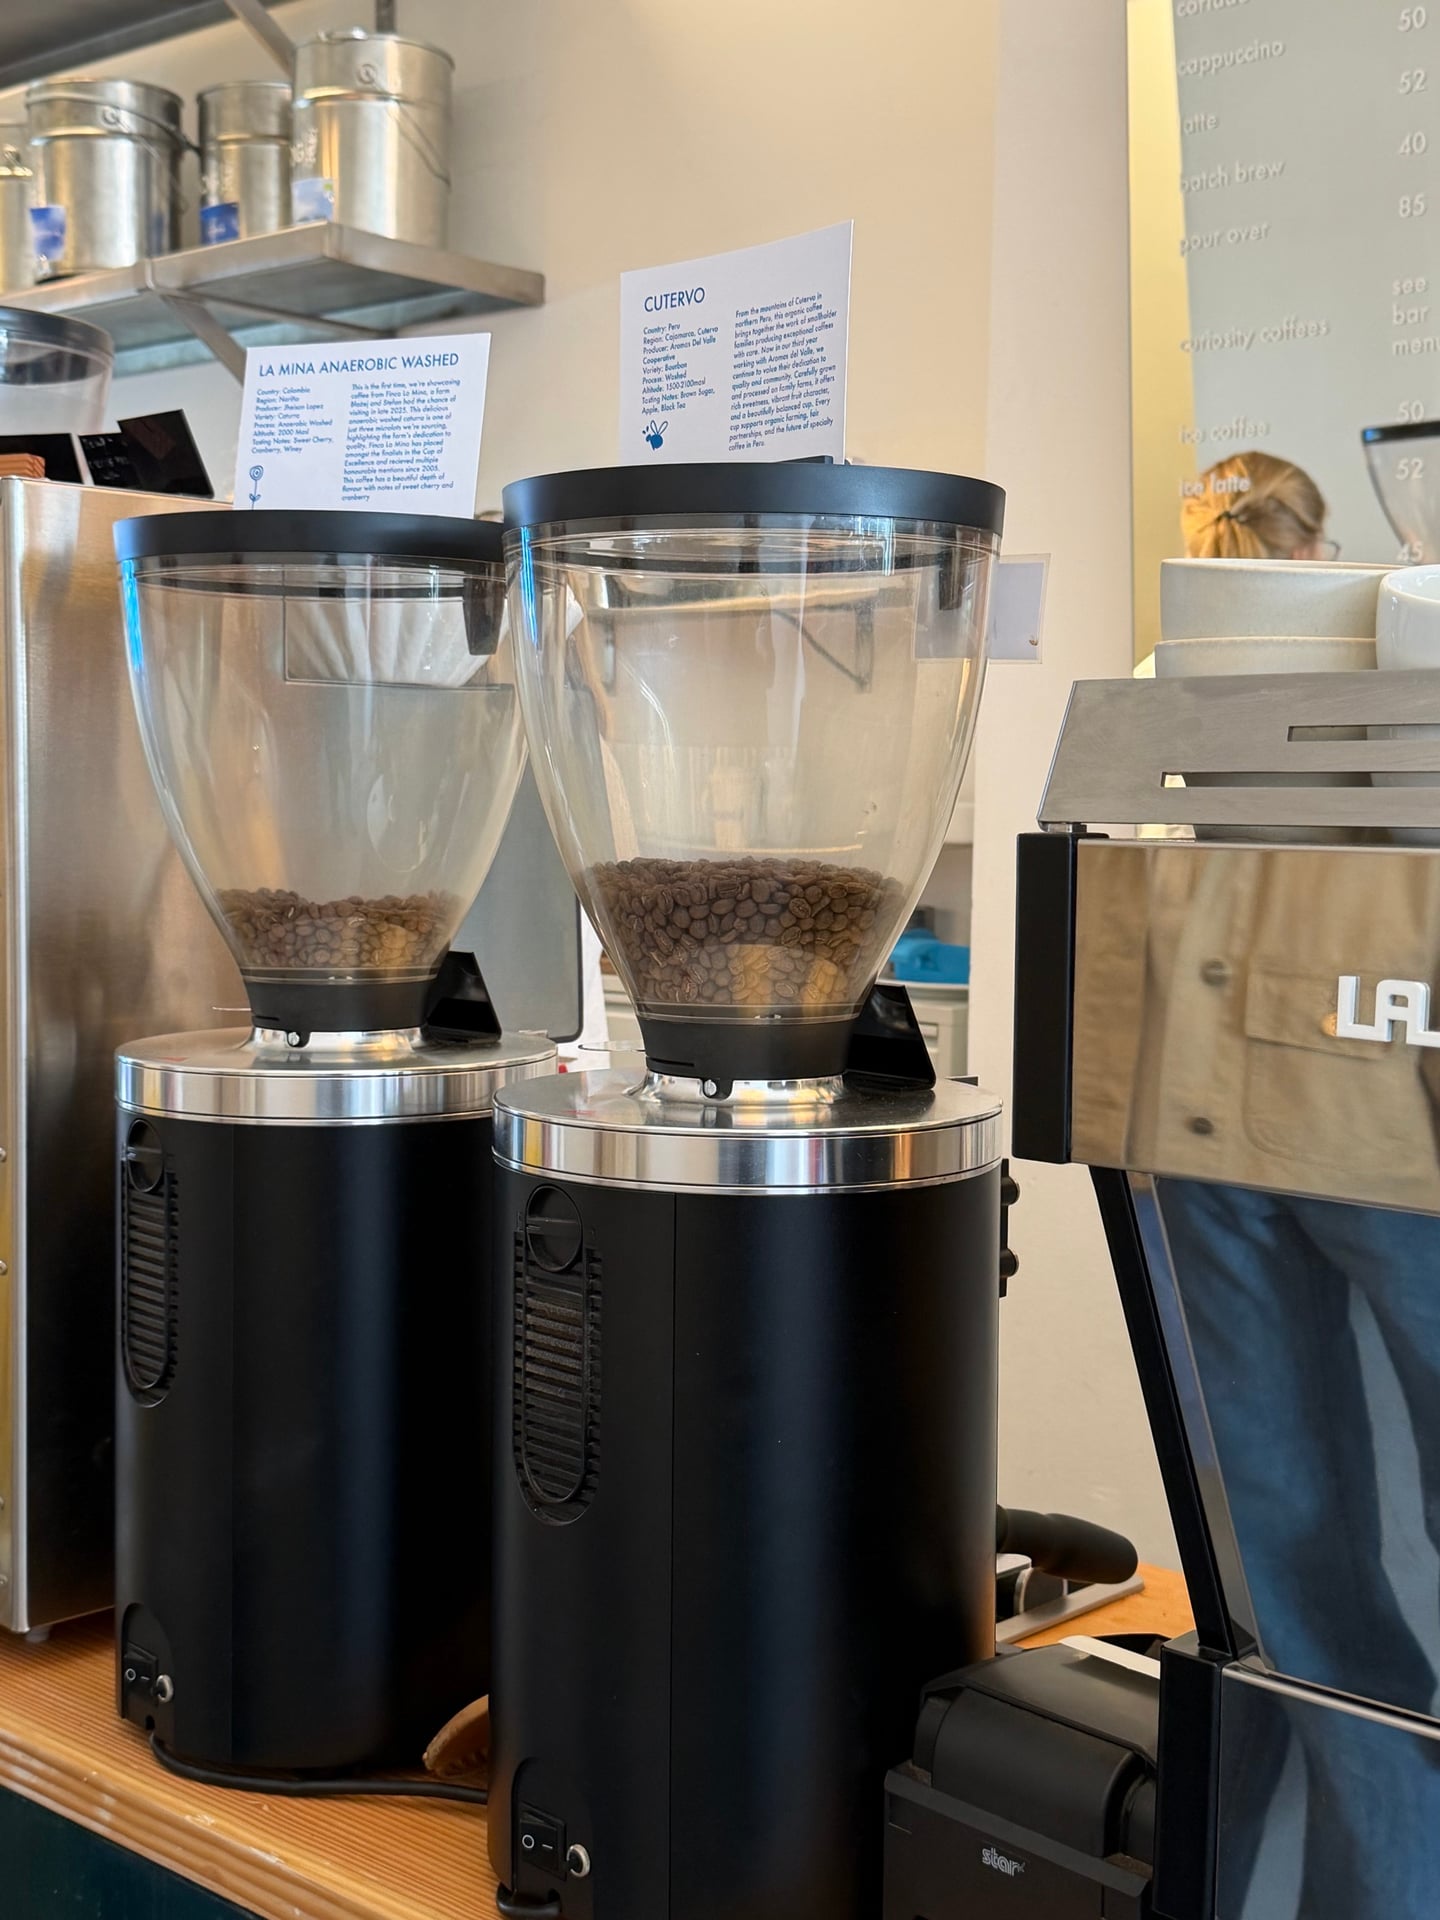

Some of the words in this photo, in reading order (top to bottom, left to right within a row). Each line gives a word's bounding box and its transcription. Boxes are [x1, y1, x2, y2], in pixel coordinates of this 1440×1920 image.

[1399, 6, 1427, 31] 50
[1178, 40, 1285, 77] cappuccino
[1400, 69, 1427, 94] 52
[1181, 112, 1217, 136] atte
[1400, 131, 1427, 155] 40
[1235, 160, 1285, 184] brew
[1399, 194, 1426, 218] 85
[1180, 230, 1221, 257] pour
[1227, 222, 1269, 244] over
[1392, 276, 1427, 297] see
[644, 287, 705, 312] CUTERVO
[1392, 303, 1429, 326] bar
[1180, 327, 1255, 352] curiosity
[1260, 314, 1330, 343] coffees
[259, 364, 275, 377] LA
[278, 361, 315, 375] MINA
[319, 357, 398, 373] ANAEROBIC
[402, 353, 459, 369] WASHED
[1397, 400, 1425, 423] 50
[1209, 417, 1270, 441] coffee
[1395, 458, 1424, 480] 52
[1179, 479, 1205, 497] ice
[1210, 473, 1250, 493] latte
[1397, 543, 1424, 562] 45
[982, 1848, 1023, 1877] star
